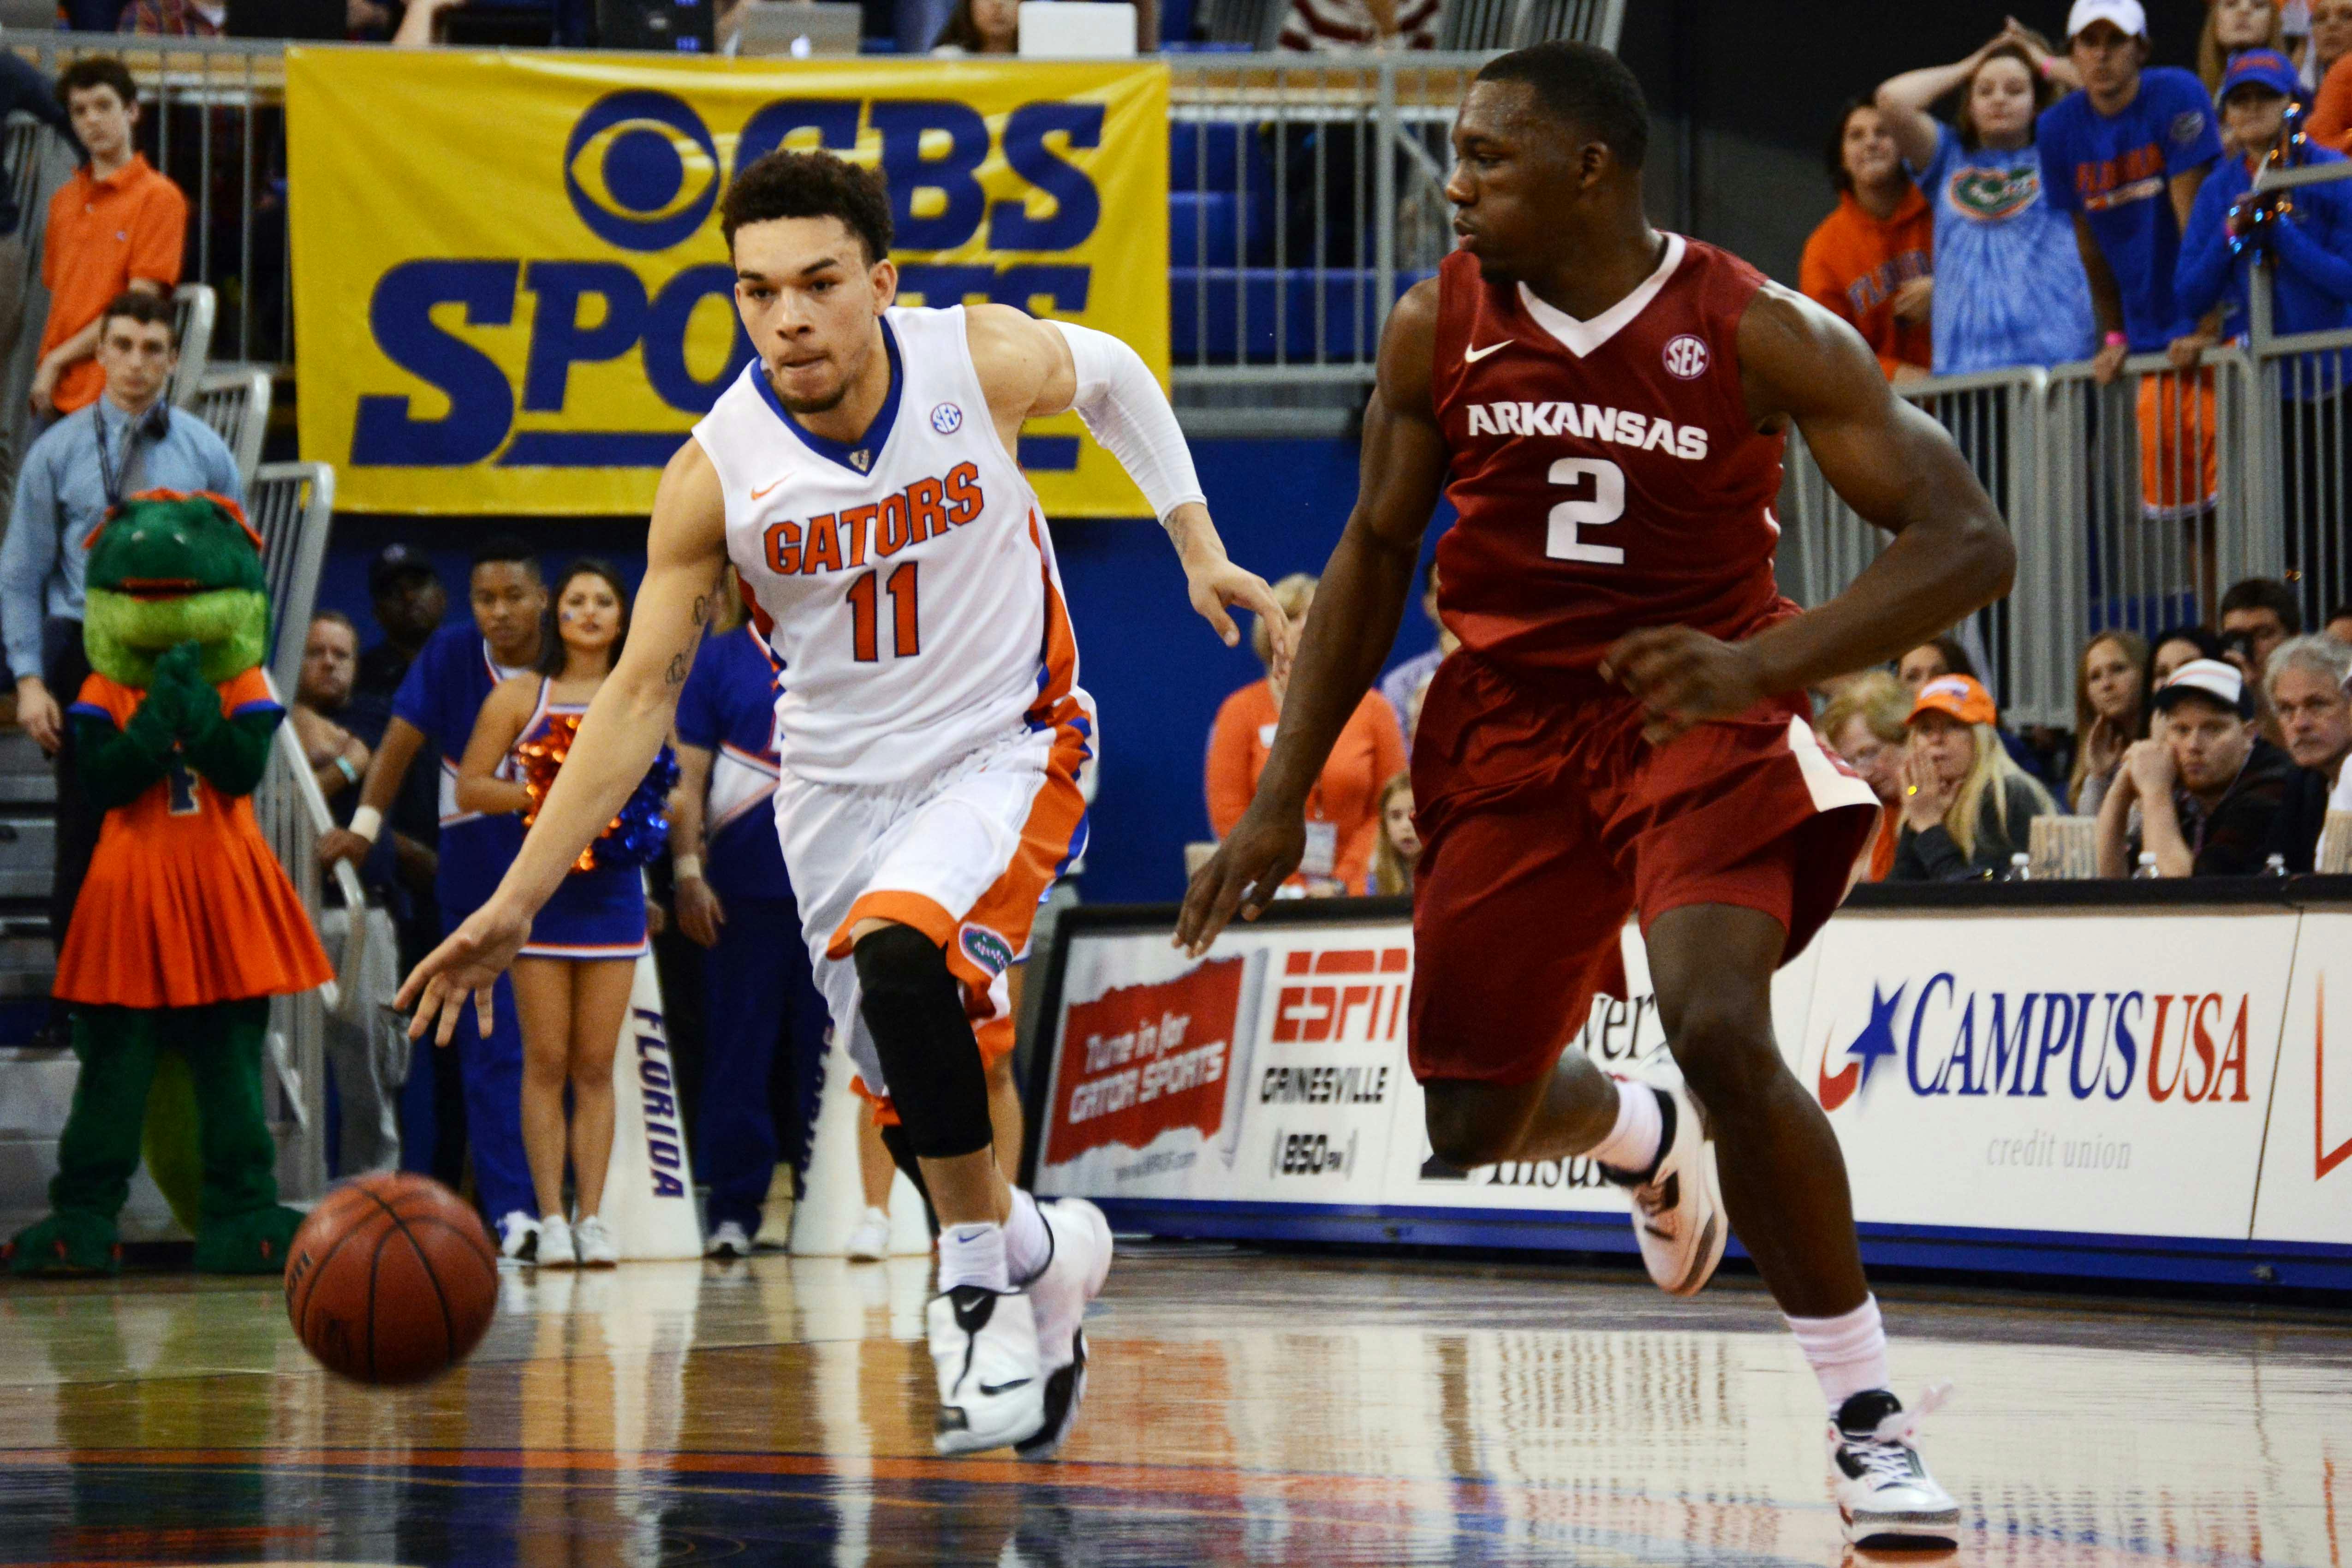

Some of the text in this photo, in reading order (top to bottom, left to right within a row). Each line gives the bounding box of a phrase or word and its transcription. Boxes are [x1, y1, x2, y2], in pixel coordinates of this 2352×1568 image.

[350, 257, 1091, 467] SPO
[1665, 337, 1707, 378] SEC
[932, 403, 962, 433] SEC
[1467, 401, 1709, 461] ARKANSAS
[763, 460, 984, 575] GATORS
[1546, 457, 1625, 565] 2
[845, 560, 921, 662] 11
[1272, 948, 1408, 1044] ESPN
[1583, 993, 1656, 1060] ver
[1135, 1019, 1157, 1058] in
[1155, 1011, 1191, 1062] for
[1905, 972, 2251, 1103] CAMPUS USA
[633, 1008, 685, 1198] FLORIDA
[1068, 1040, 1227, 1125] GATOR SPORTS
[1260, 1066, 1388, 1104] GAINESVILLE
[1282, 1133, 1328, 1175] 850
[1486, 1157, 1609, 1189] Insu
[1986, 1127, 2132, 1170] credit union
